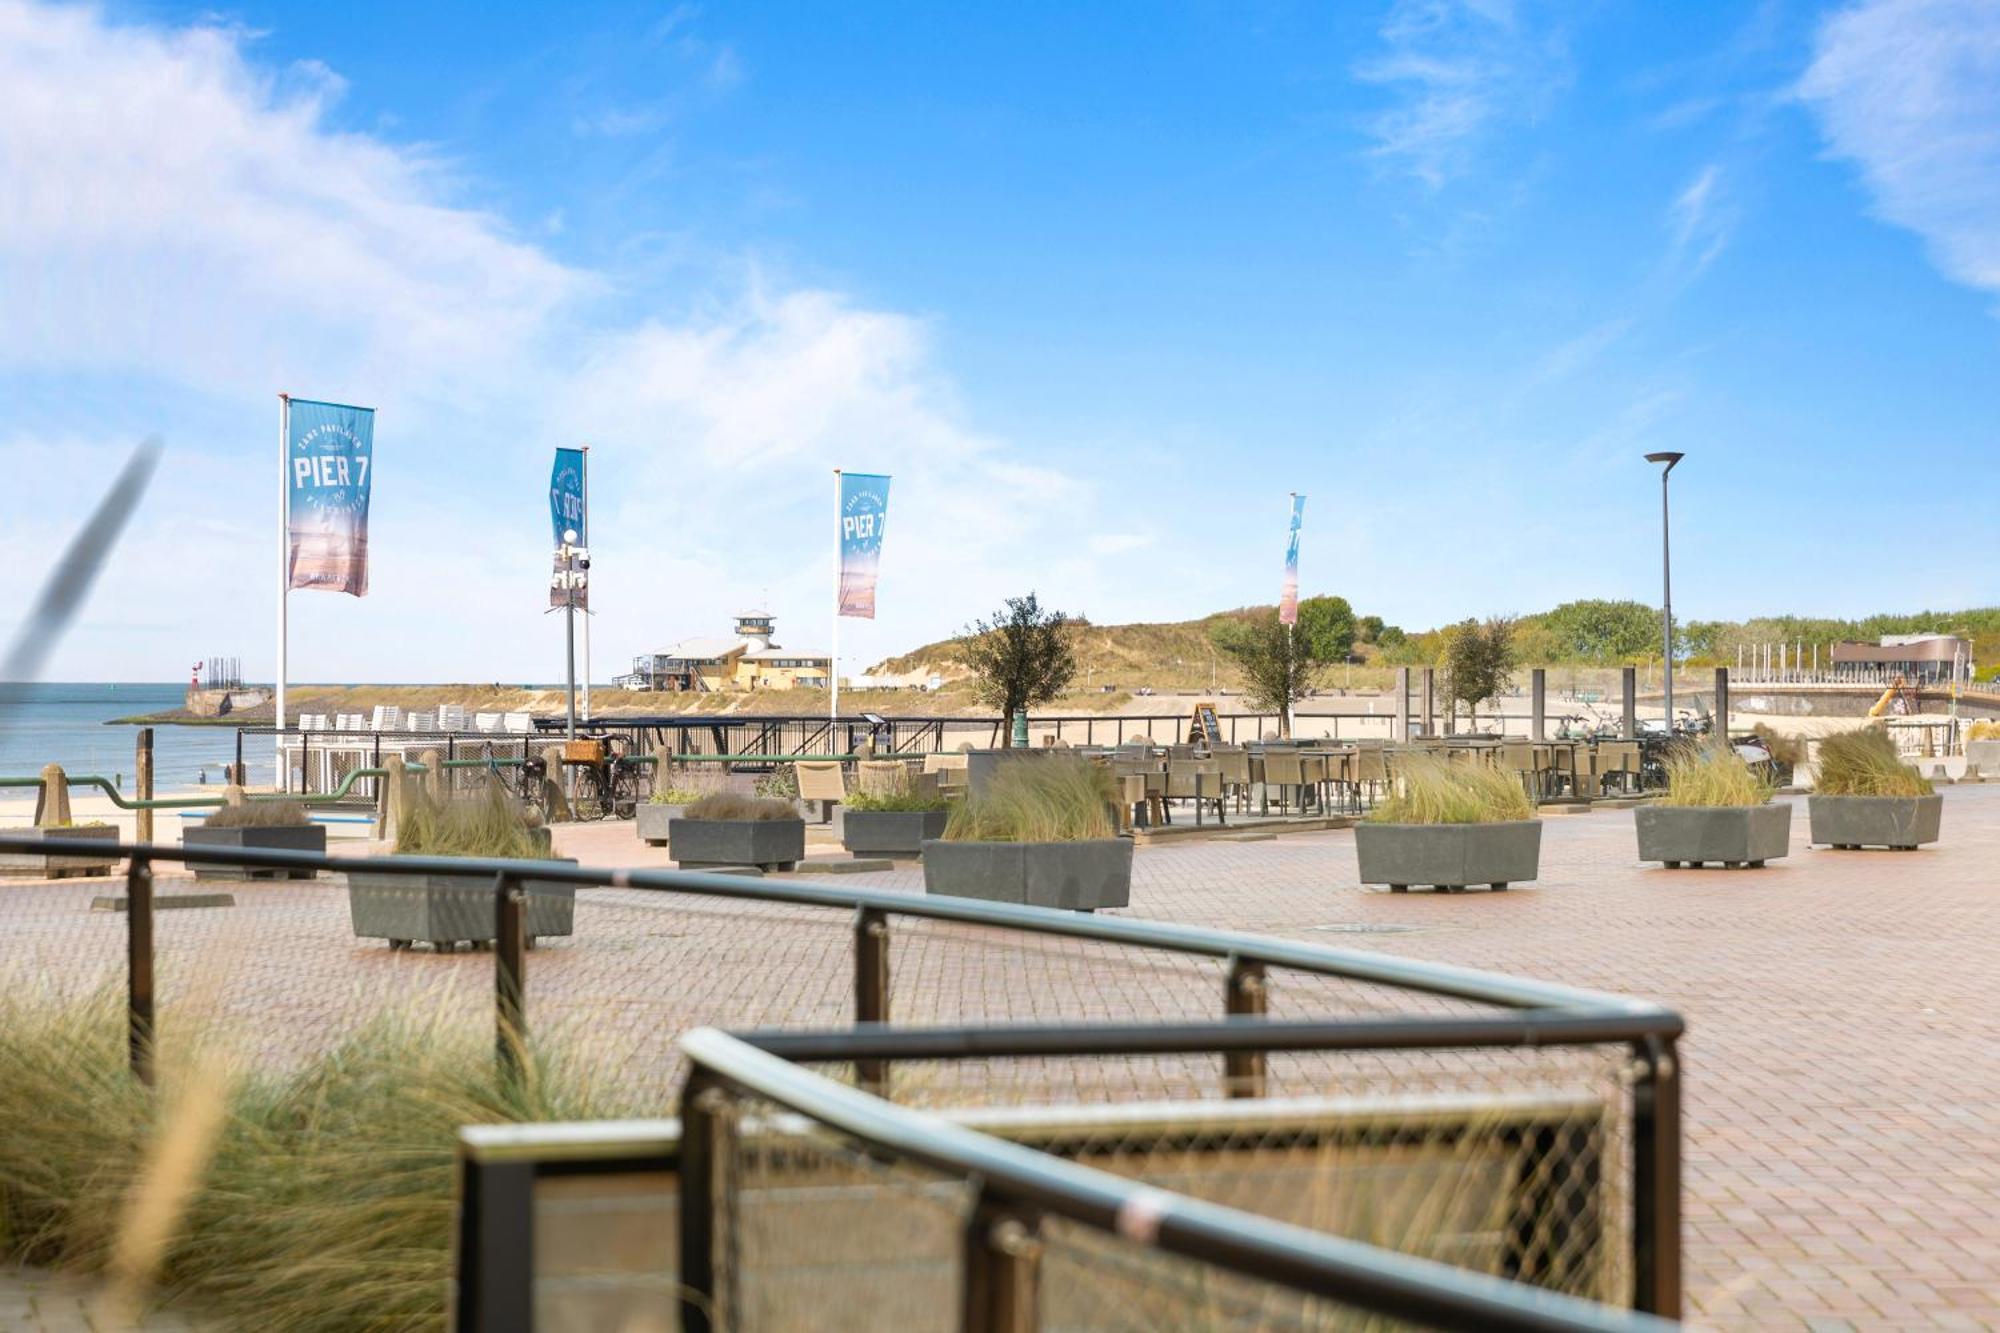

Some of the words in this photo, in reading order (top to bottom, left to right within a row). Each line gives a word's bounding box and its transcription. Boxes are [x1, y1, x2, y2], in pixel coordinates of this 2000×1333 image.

[294, 455, 351, 489] PIER
[355, 455, 369, 487] 7
[843, 513, 874, 541] PIER
